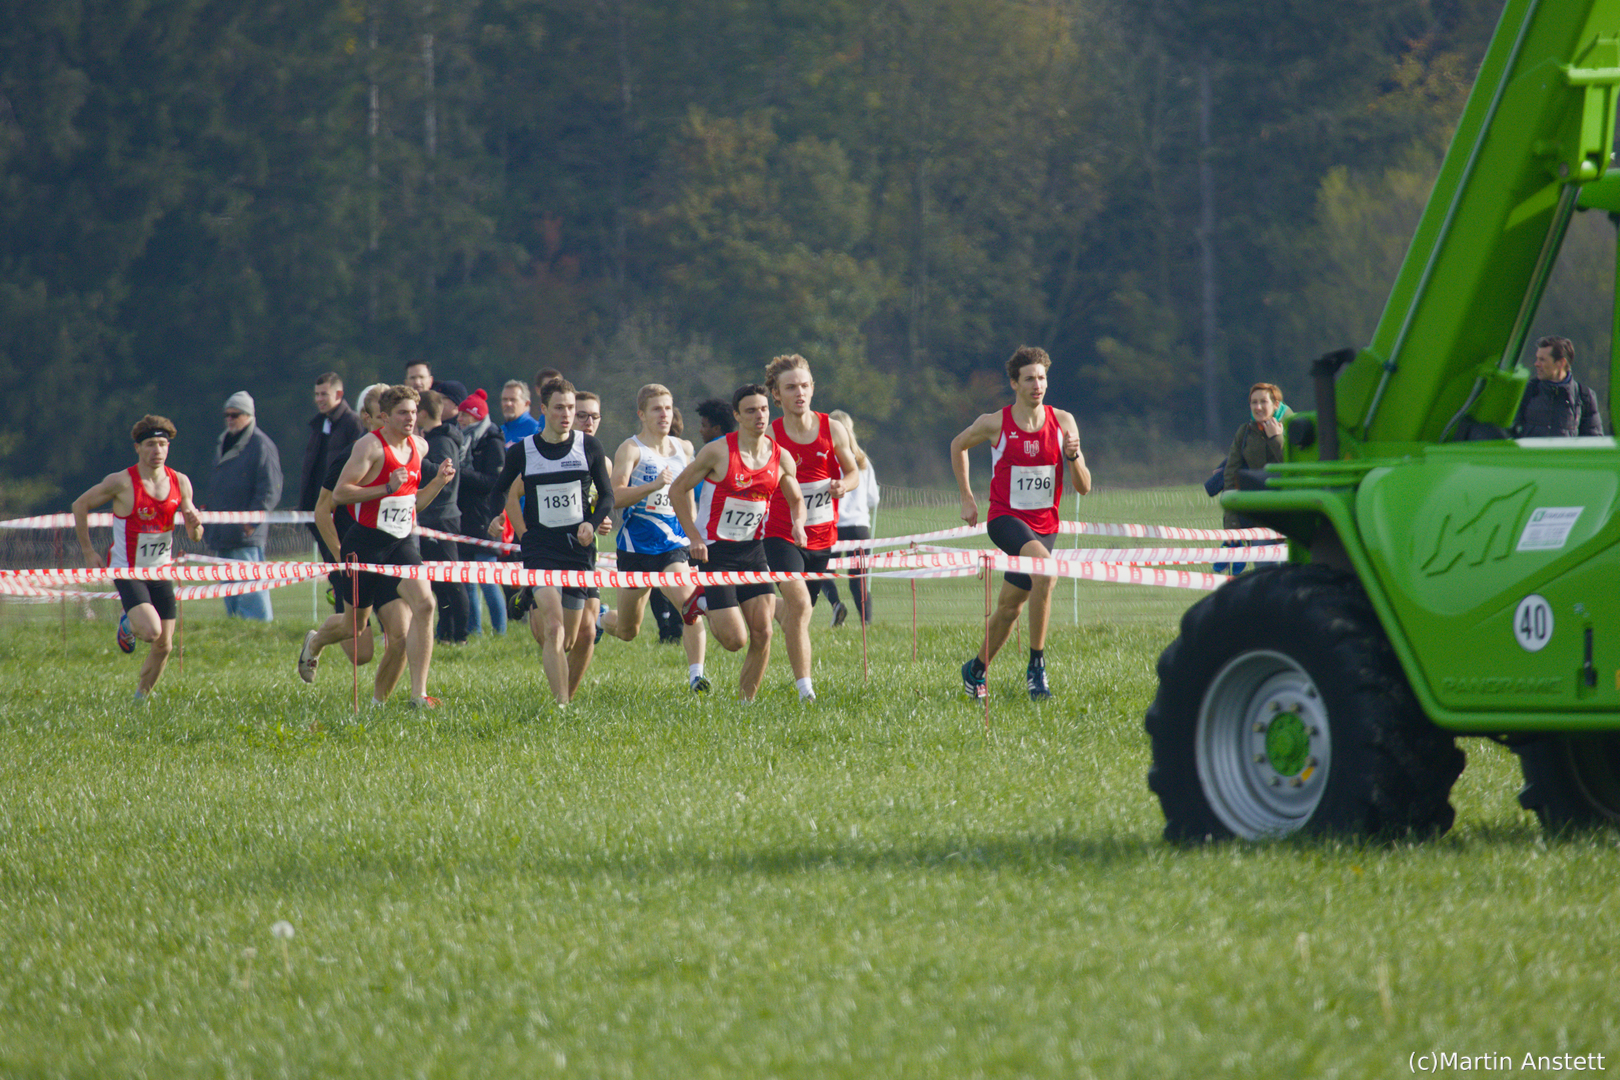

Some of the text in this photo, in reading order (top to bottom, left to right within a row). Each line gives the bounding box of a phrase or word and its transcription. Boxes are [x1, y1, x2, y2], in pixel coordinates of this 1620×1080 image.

[1017, 476, 1051, 491] 1796
[543, 492, 577, 509] 1831
[654, 493, 673, 507] 33
[804, 490, 831, 510] 722
[381, 506, 413, 523] 1725
[725, 509, 763, 527] 1723
[1520, 604, 1547, 640] 40
